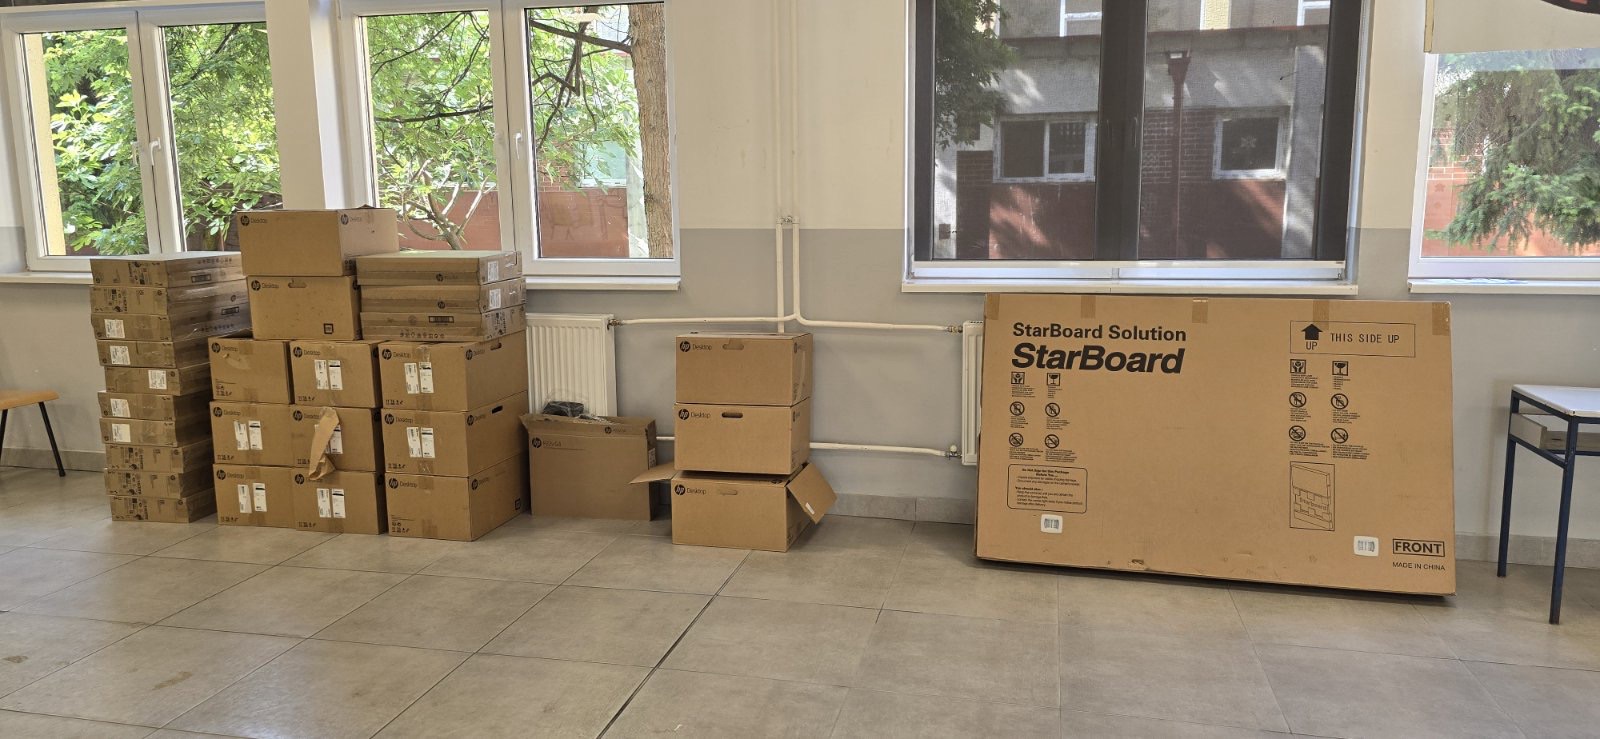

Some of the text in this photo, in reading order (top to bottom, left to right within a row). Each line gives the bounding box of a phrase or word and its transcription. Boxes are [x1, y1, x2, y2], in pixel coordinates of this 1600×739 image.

[1013, 322, 1187, 342] StarBoard Solution
[1330, 333, 1400, 343] THIS SIDE UP
[680, 341, 712, 353] hp Desktop
[1306, 341, 1318, 350] UP
[1011, 342, 1186, 374] StarBoard
[678, 408, 710, 420] hp Desktop
[389, 478, 399, 489] hp
[675, 484, 707, 496] hp Desktop
[1395, 541, 1442, 554] FRONT
